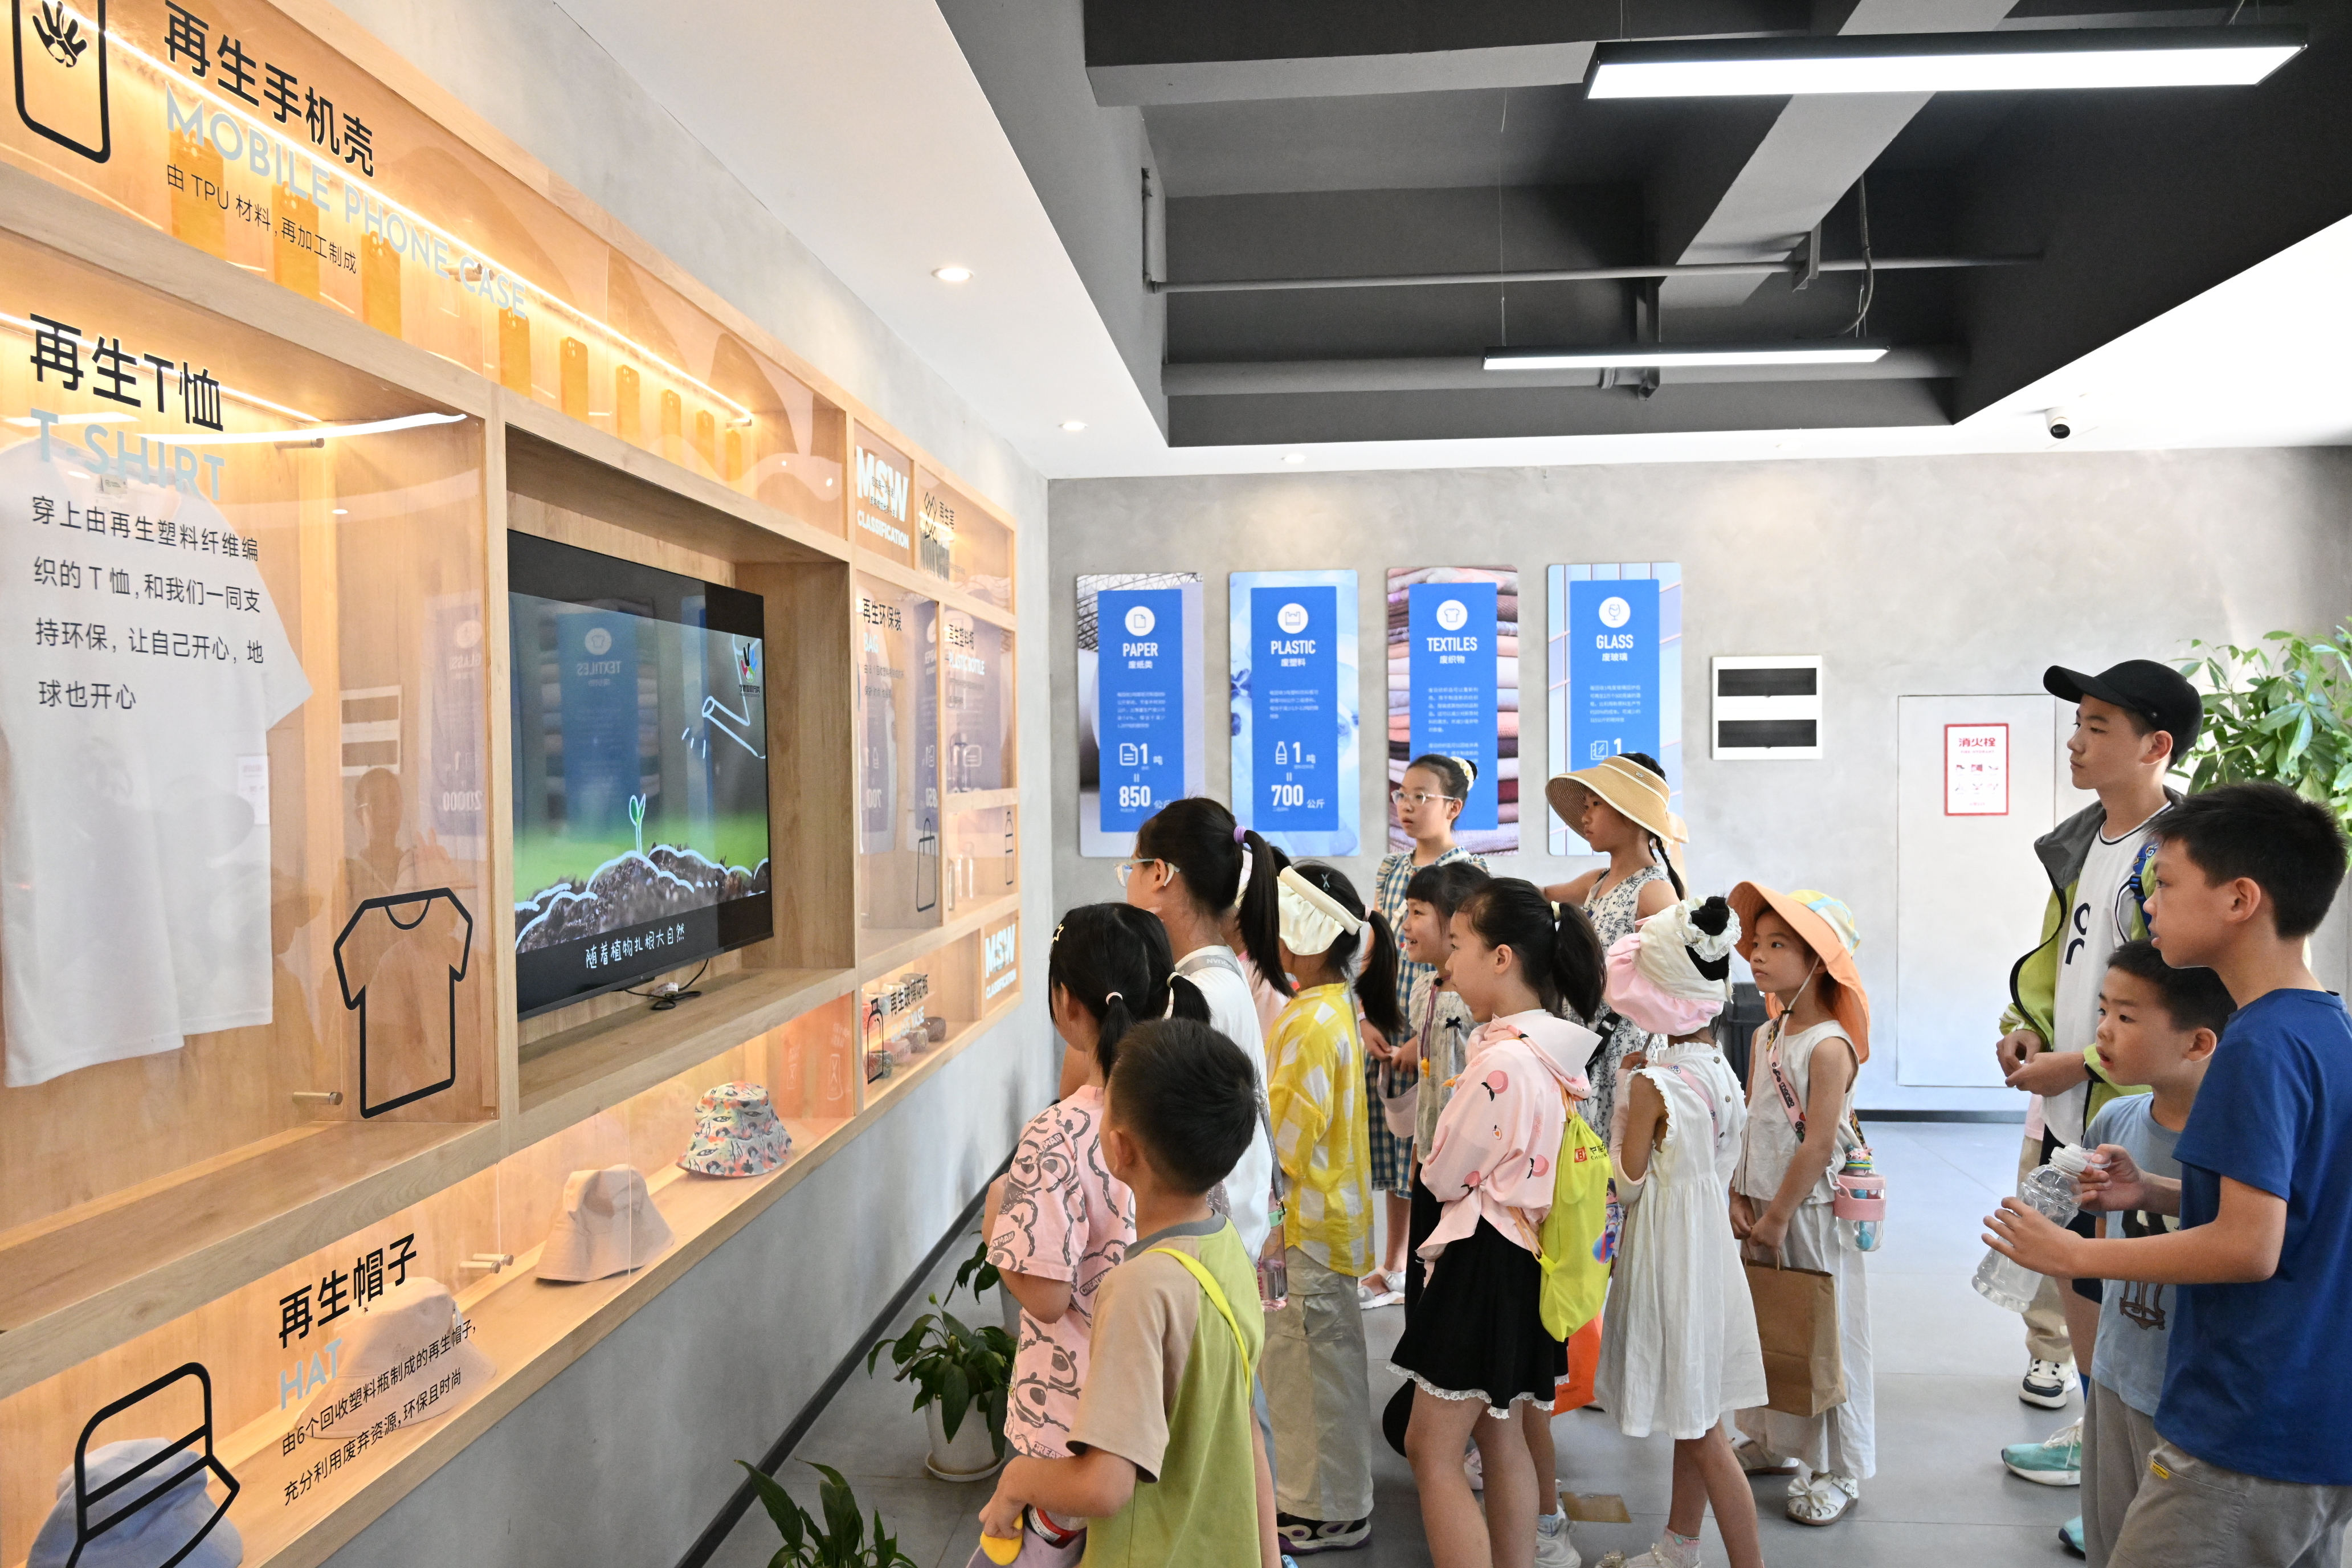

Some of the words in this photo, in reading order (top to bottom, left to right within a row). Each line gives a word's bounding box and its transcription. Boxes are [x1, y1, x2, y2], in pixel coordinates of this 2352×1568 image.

[165, 0, 374, 178] 再生手机壳
[166, 82, 331, 212] MOBILE
[345, 182, 450, 280] PHONE
[459, 260, 526, 318] CASE
[191, 173, 229, 210] TPU
[30, 313, 224, 432] 再生T恤
[856, 445, 909, 522] MSW
[32, 495, 259, 562] 穿上由再生塑料纤维编
[858, 509, 909, 550] CLASSIFICATION
[863, 598, 902, 632] 再生环保袋
[864, 632, 879, 654] BAG
[1122, 642, 1159, 657] PAPER
[1271, 639, 1316, 655] PLASTIC
[1426, 636, 1478, 652] TEXTILES
[1596, 634, 1634, 649] GLASS
[1281, 658, 1306, 667] 废塑料
[1439, 655, 1465, 664] 废织物
[1602, 652, 1628, 662] 废玻璃
[39, 680, 137, 709] 球也开心
[1140, 742, 1148, 765] 1
[1292, 741, 1301, 763] 1
[1614, 738, 1622, 755] 1
[1959, 737, 1996, 747] 消火栓
[1118, 785, 1151, 807] 850
[1271, 784, 1304, 806] 700
[1306, 798, 1325, 809] 公斤
[585, 922, 685, 969] 随着植物扎根大自然
[985, 923, 1016, 979] MSW
[278, 1232, 418, 1349] 再生帽子
[279, 1338, 342, 1411] HAT
